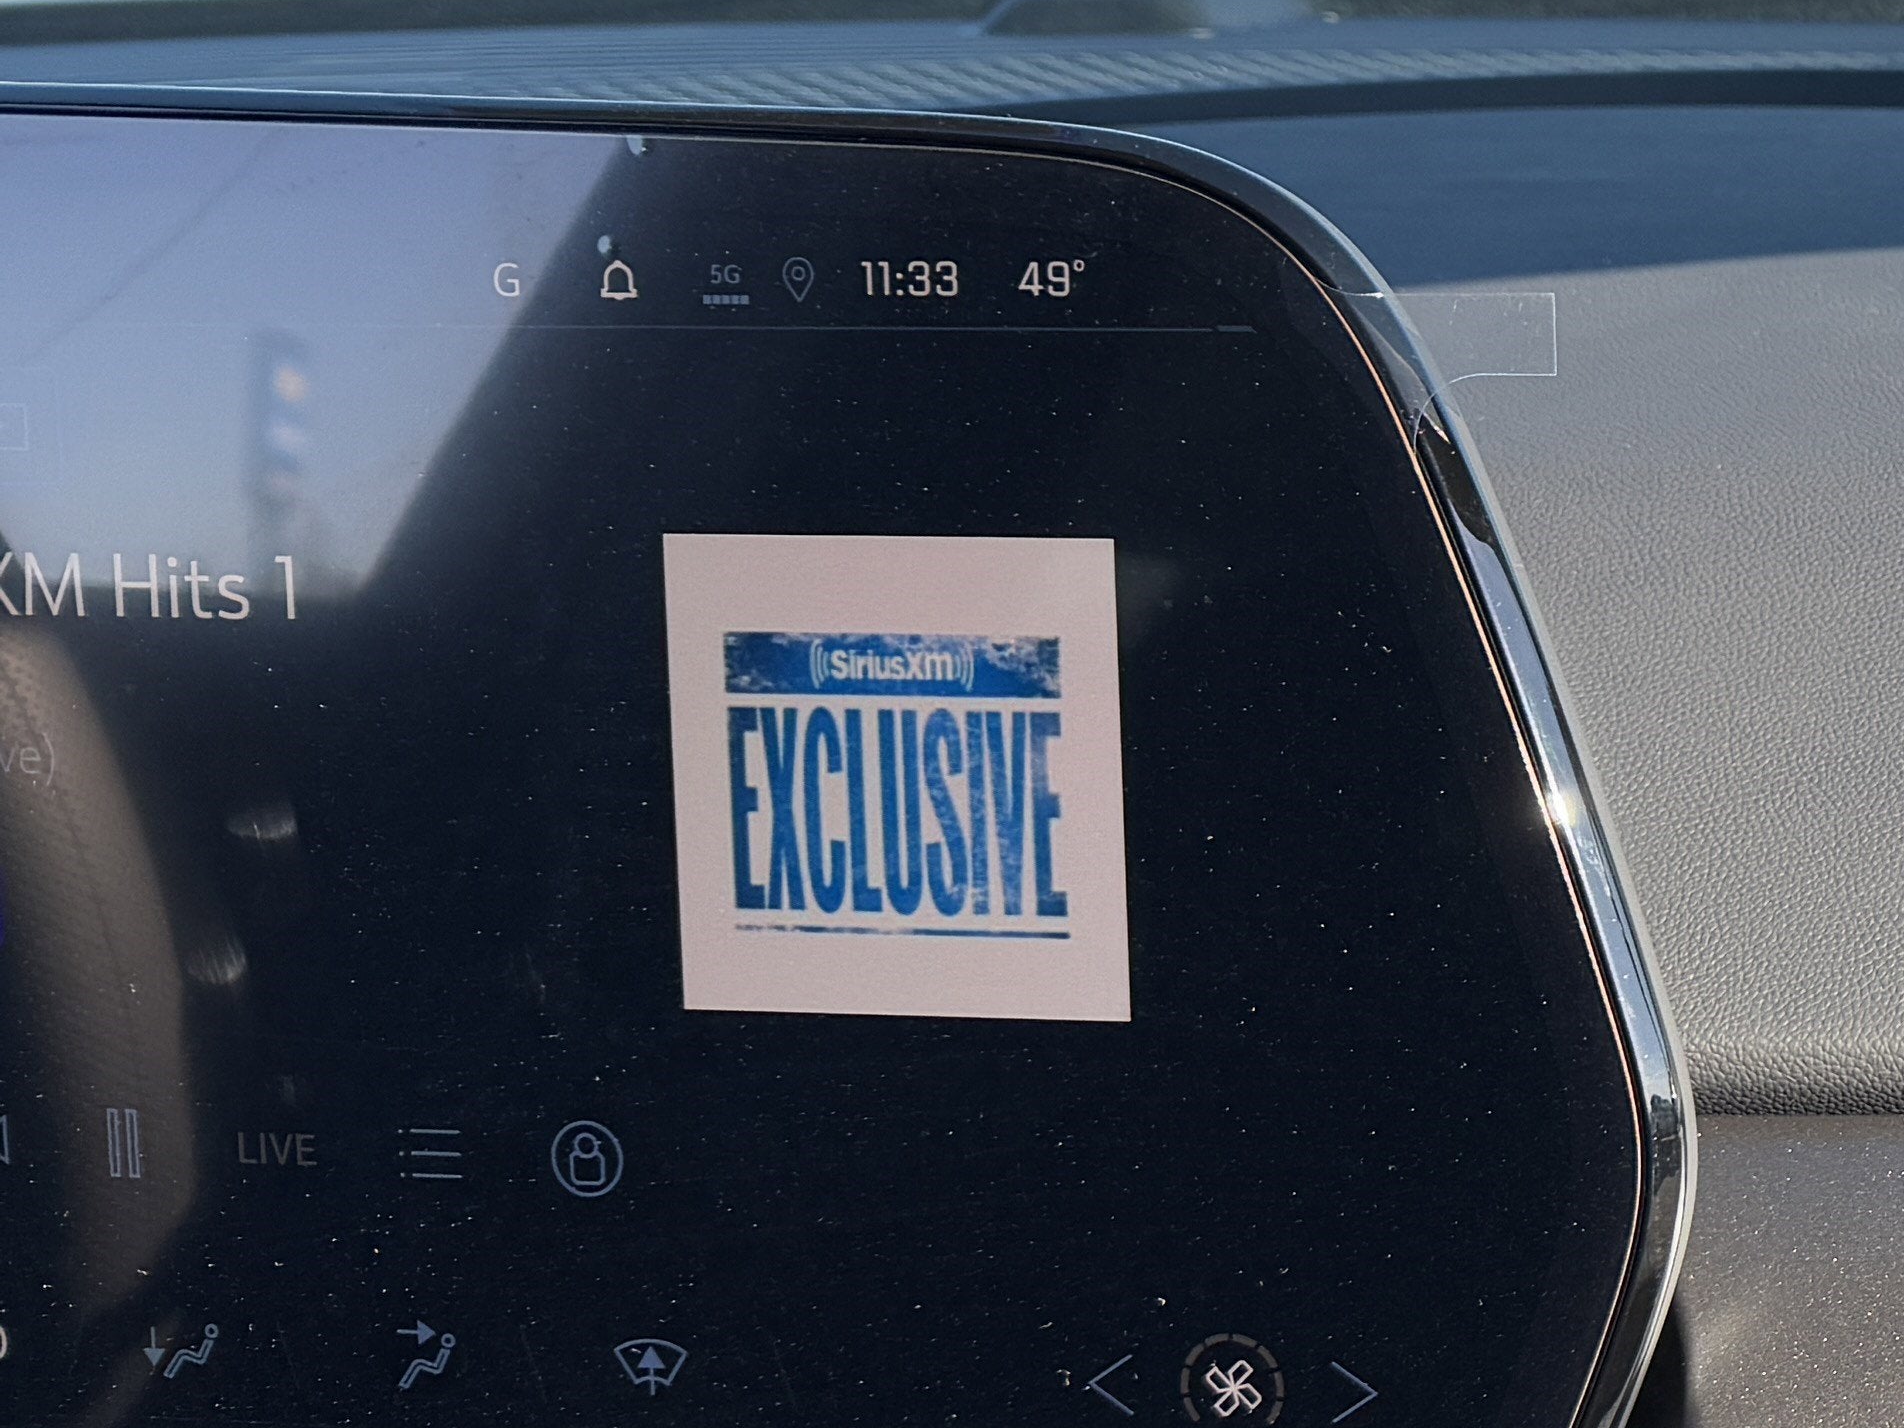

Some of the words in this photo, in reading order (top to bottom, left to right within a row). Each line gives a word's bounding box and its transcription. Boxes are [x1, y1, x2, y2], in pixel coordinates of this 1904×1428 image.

[709, 264, 741, 285] 5G
[861, 260, 959, 297] 11:33
[1018, 259, 1085, 297] 49°
[113, 553, 251, 620] Hits
[275, 555, 296, 620] 1
[727, 706, 1069, 918] EXCLUSIVE
[237, 1131, 318, 1167] LIVE
